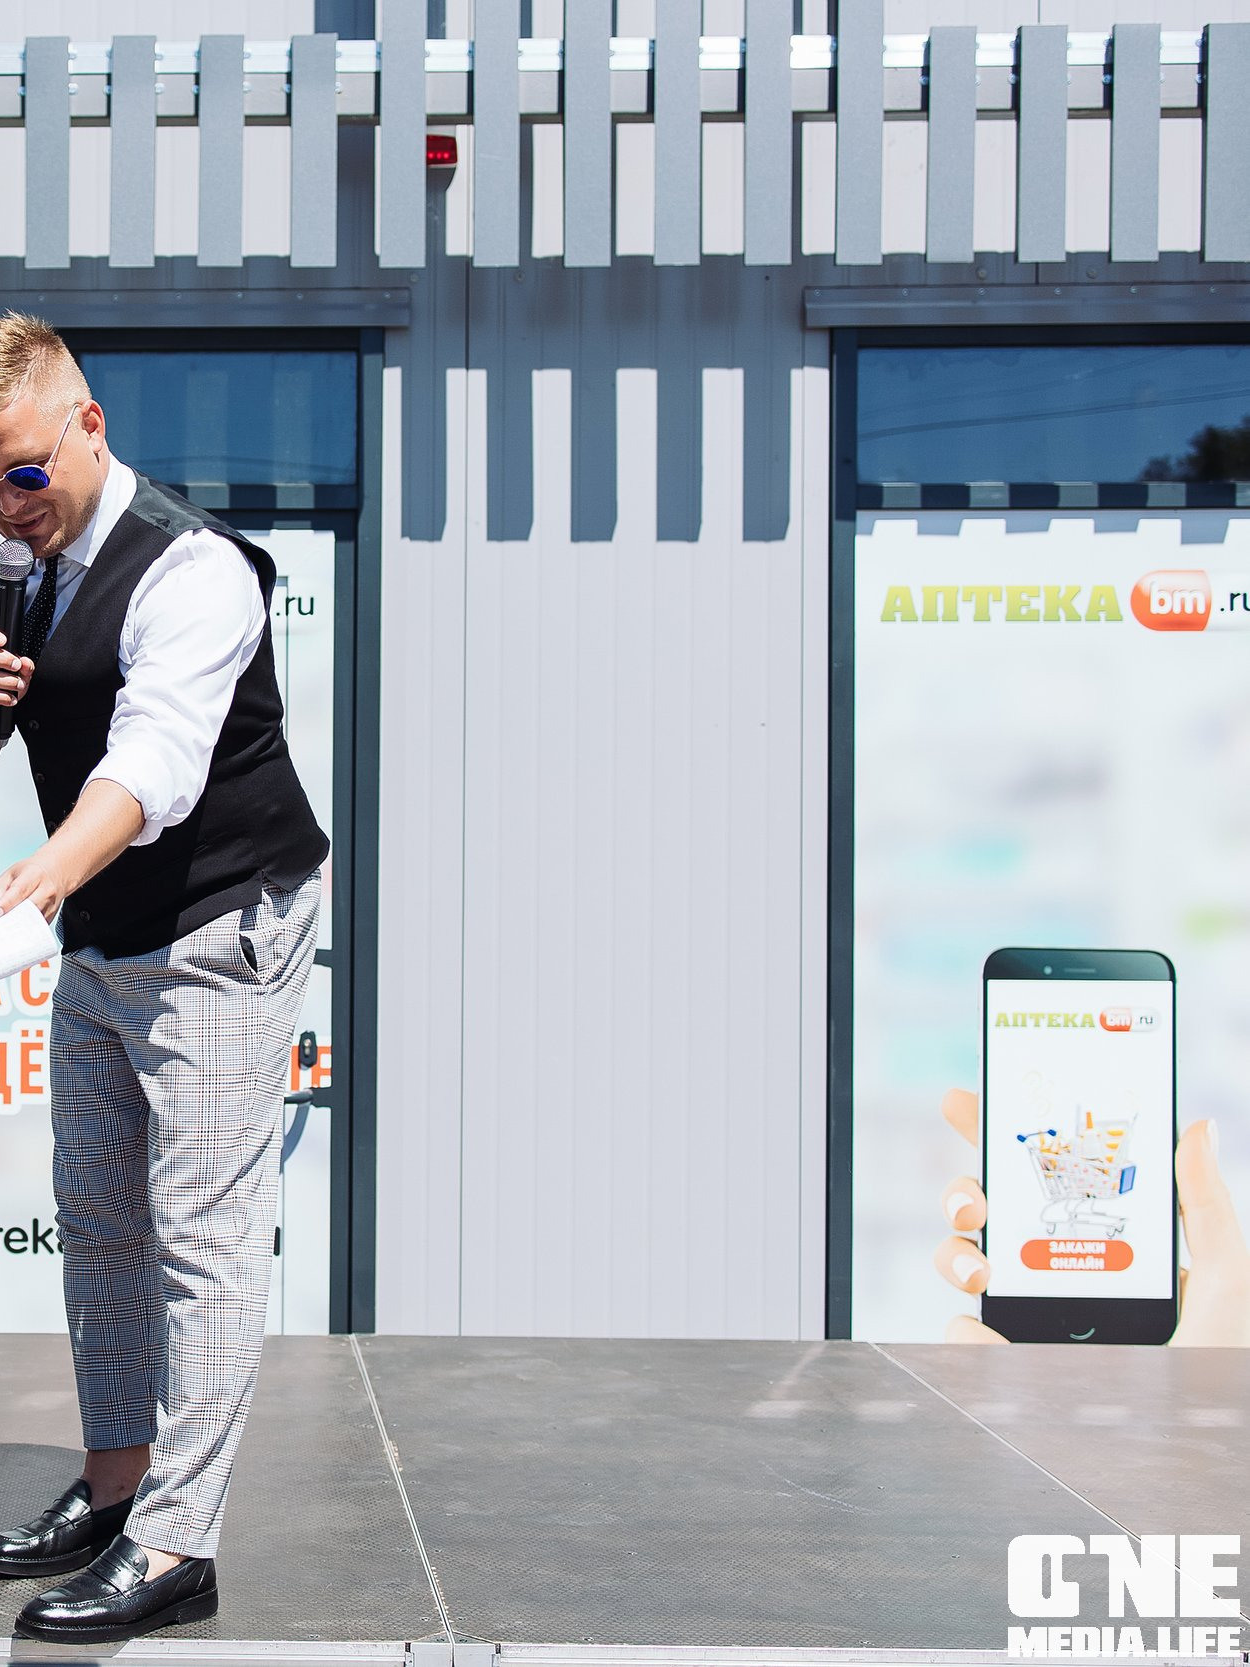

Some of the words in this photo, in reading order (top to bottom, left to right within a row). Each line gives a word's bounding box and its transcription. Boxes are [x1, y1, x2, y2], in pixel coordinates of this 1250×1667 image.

[276, 596, 315, 616] .ru
[880, 585, 1124, 622] АПТЕКА
[995, 1011, 1096, 1028] АПТЕКА
